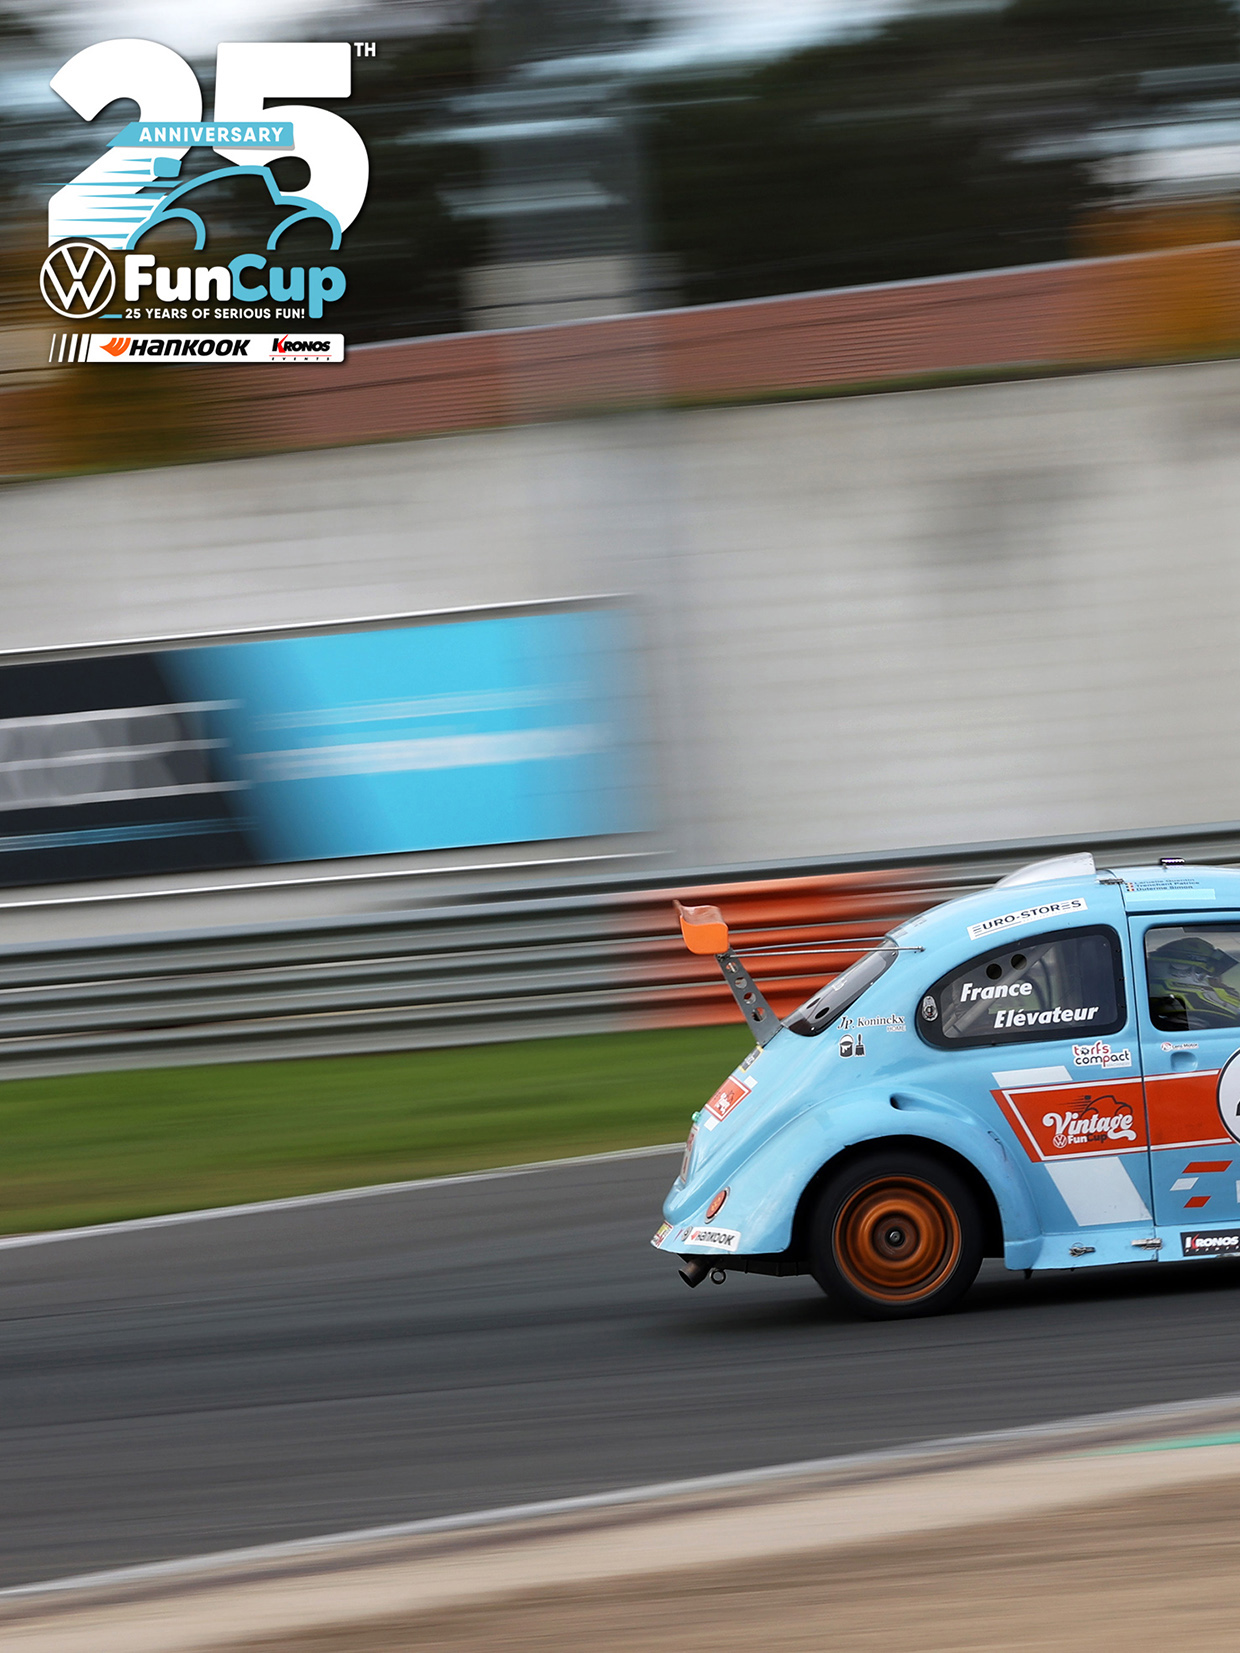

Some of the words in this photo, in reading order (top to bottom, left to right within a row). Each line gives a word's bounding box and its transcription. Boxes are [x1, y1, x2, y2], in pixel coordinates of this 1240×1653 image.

[960, 982, 1033, 1002] France
[858, 1014, 905, 1027] Koninckx
[994, 1006, 1099, 1028] Elévateur
[1074, 1041, 1110, 1056] torfs
[1075, 1050, 1130, 1067] compact
[1042, 1111, 1137, 1141] Vintage
[1185, 1234, 1239, 1249] KRONOS
